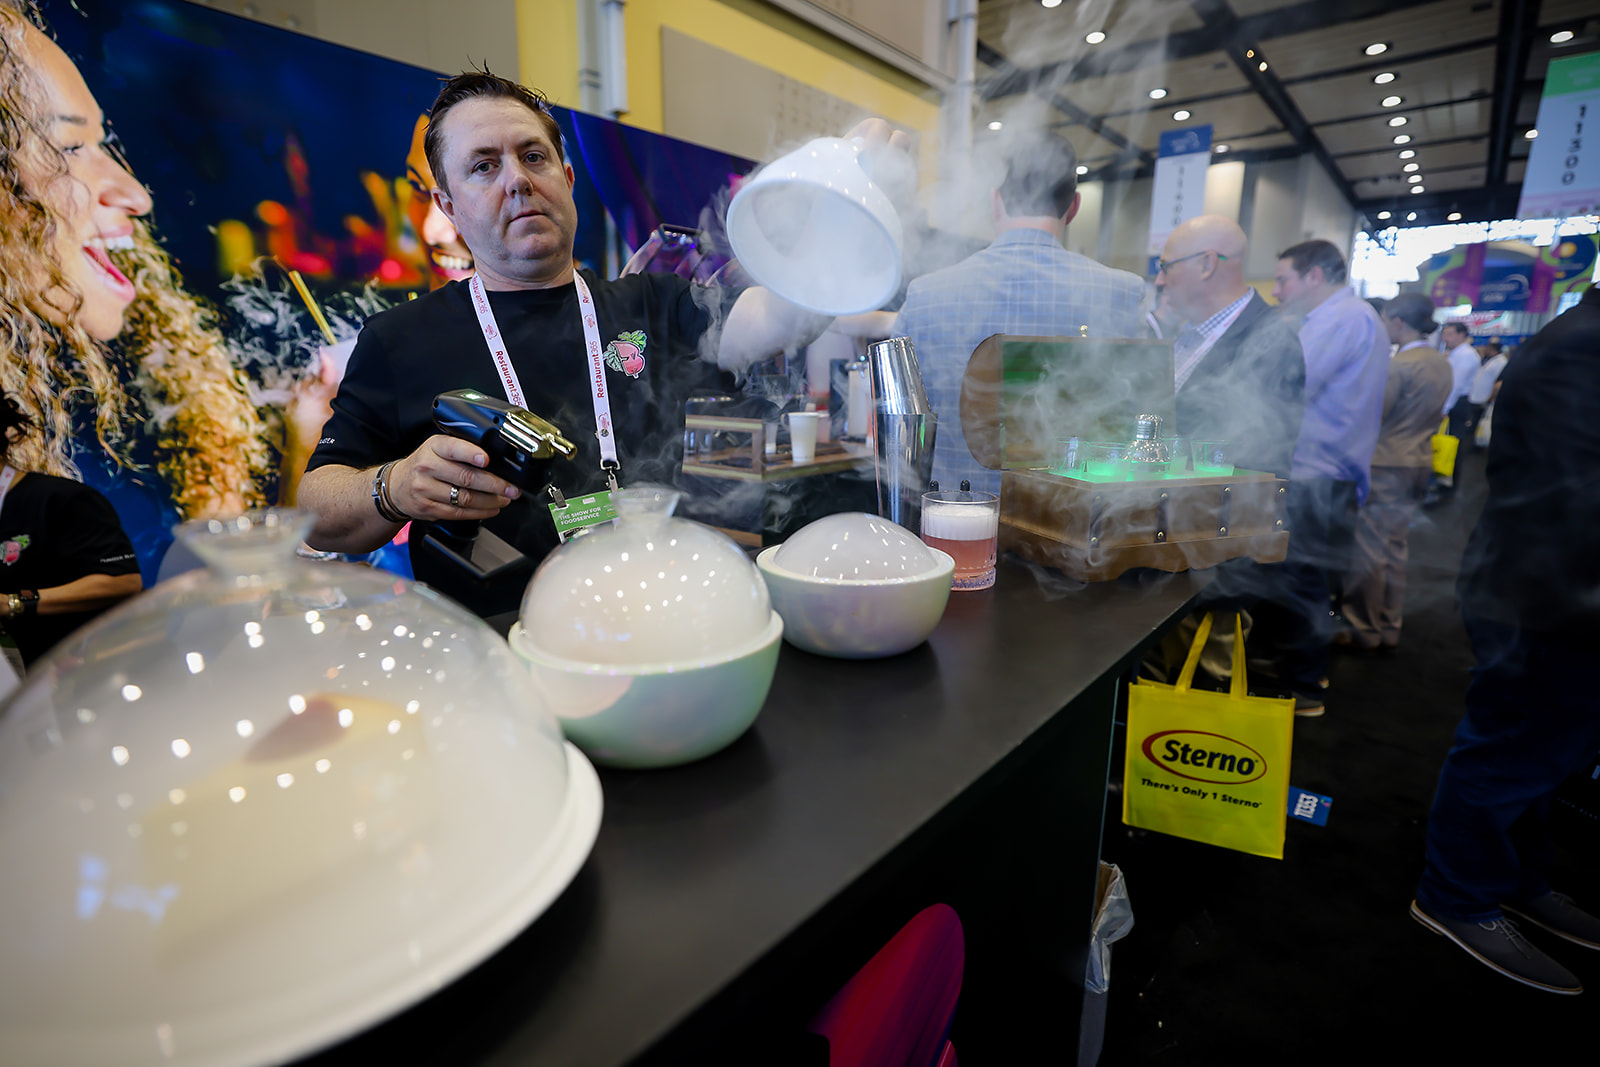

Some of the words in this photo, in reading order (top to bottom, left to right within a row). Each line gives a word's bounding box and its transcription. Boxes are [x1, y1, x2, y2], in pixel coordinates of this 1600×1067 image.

[495, 350, 523, 407] Restaurant365
[589, 341, 604, 398] Restaurant365
[561, 512, 600, 525] FOODSERVICE
[571, 509, 589, 518] SHOW
[590, 506, 601, 514] FOR
[1162, 739, 1255, 776] Sterno
[1141, 778, 1179, 793] There's
[1182, 786, 1208, 800] Only
[1212, 792, 1218, 800] 1
[1221, 794, 1260, 809] Sterno
